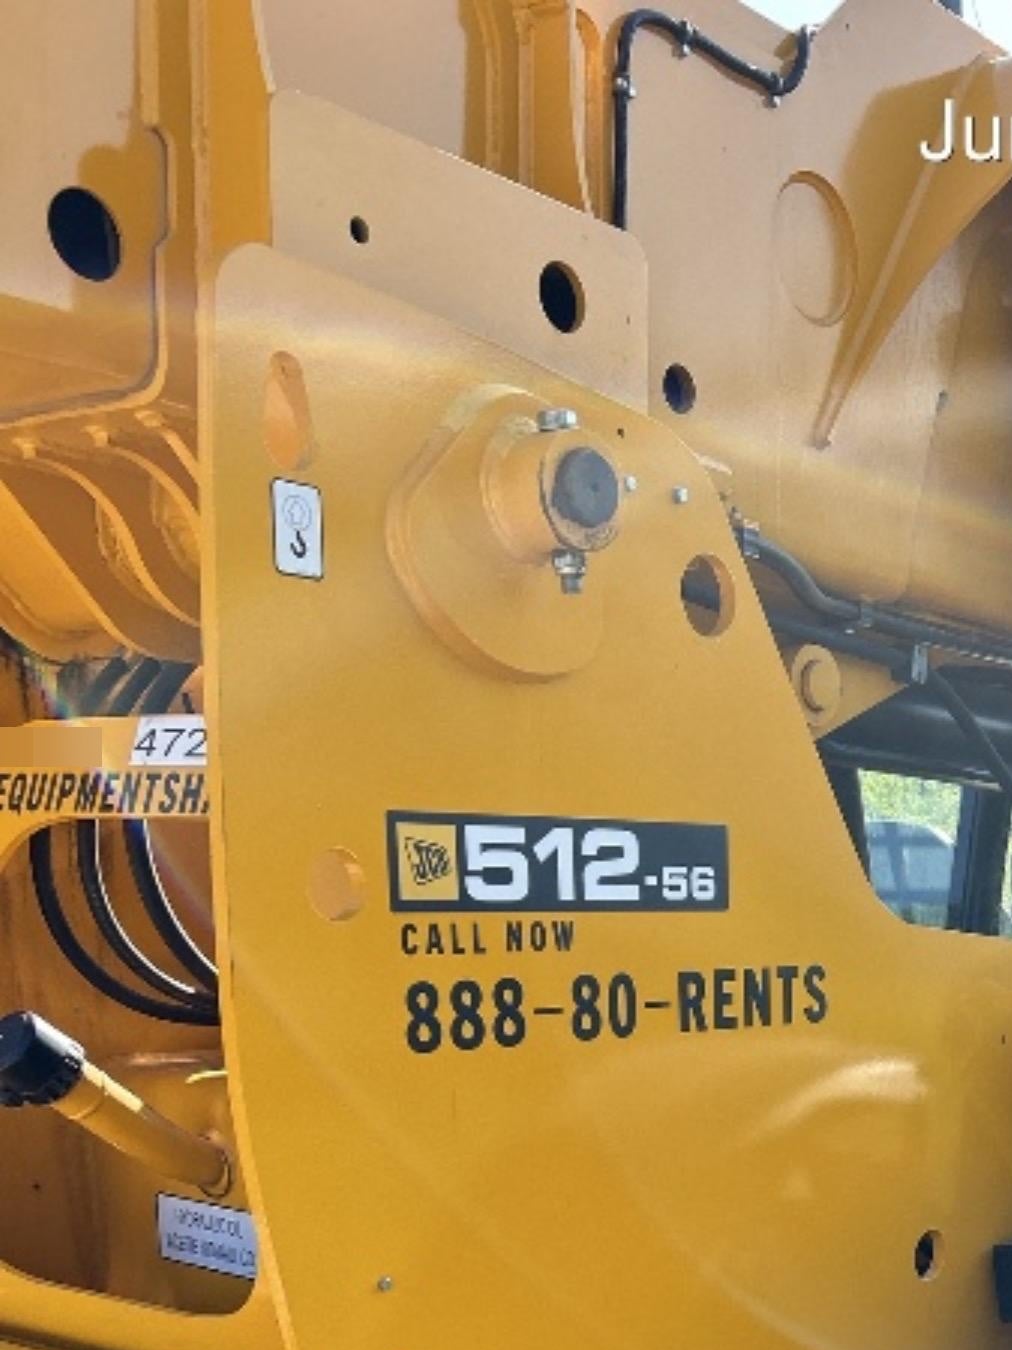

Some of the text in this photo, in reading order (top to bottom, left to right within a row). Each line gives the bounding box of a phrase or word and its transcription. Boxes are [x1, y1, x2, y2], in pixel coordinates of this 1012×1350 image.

[463, 823, 716, 903] 512-56
[401, 920, 575, 956] CALL NOW
[405, 964, 828, 1055] 888-80-RENTS
